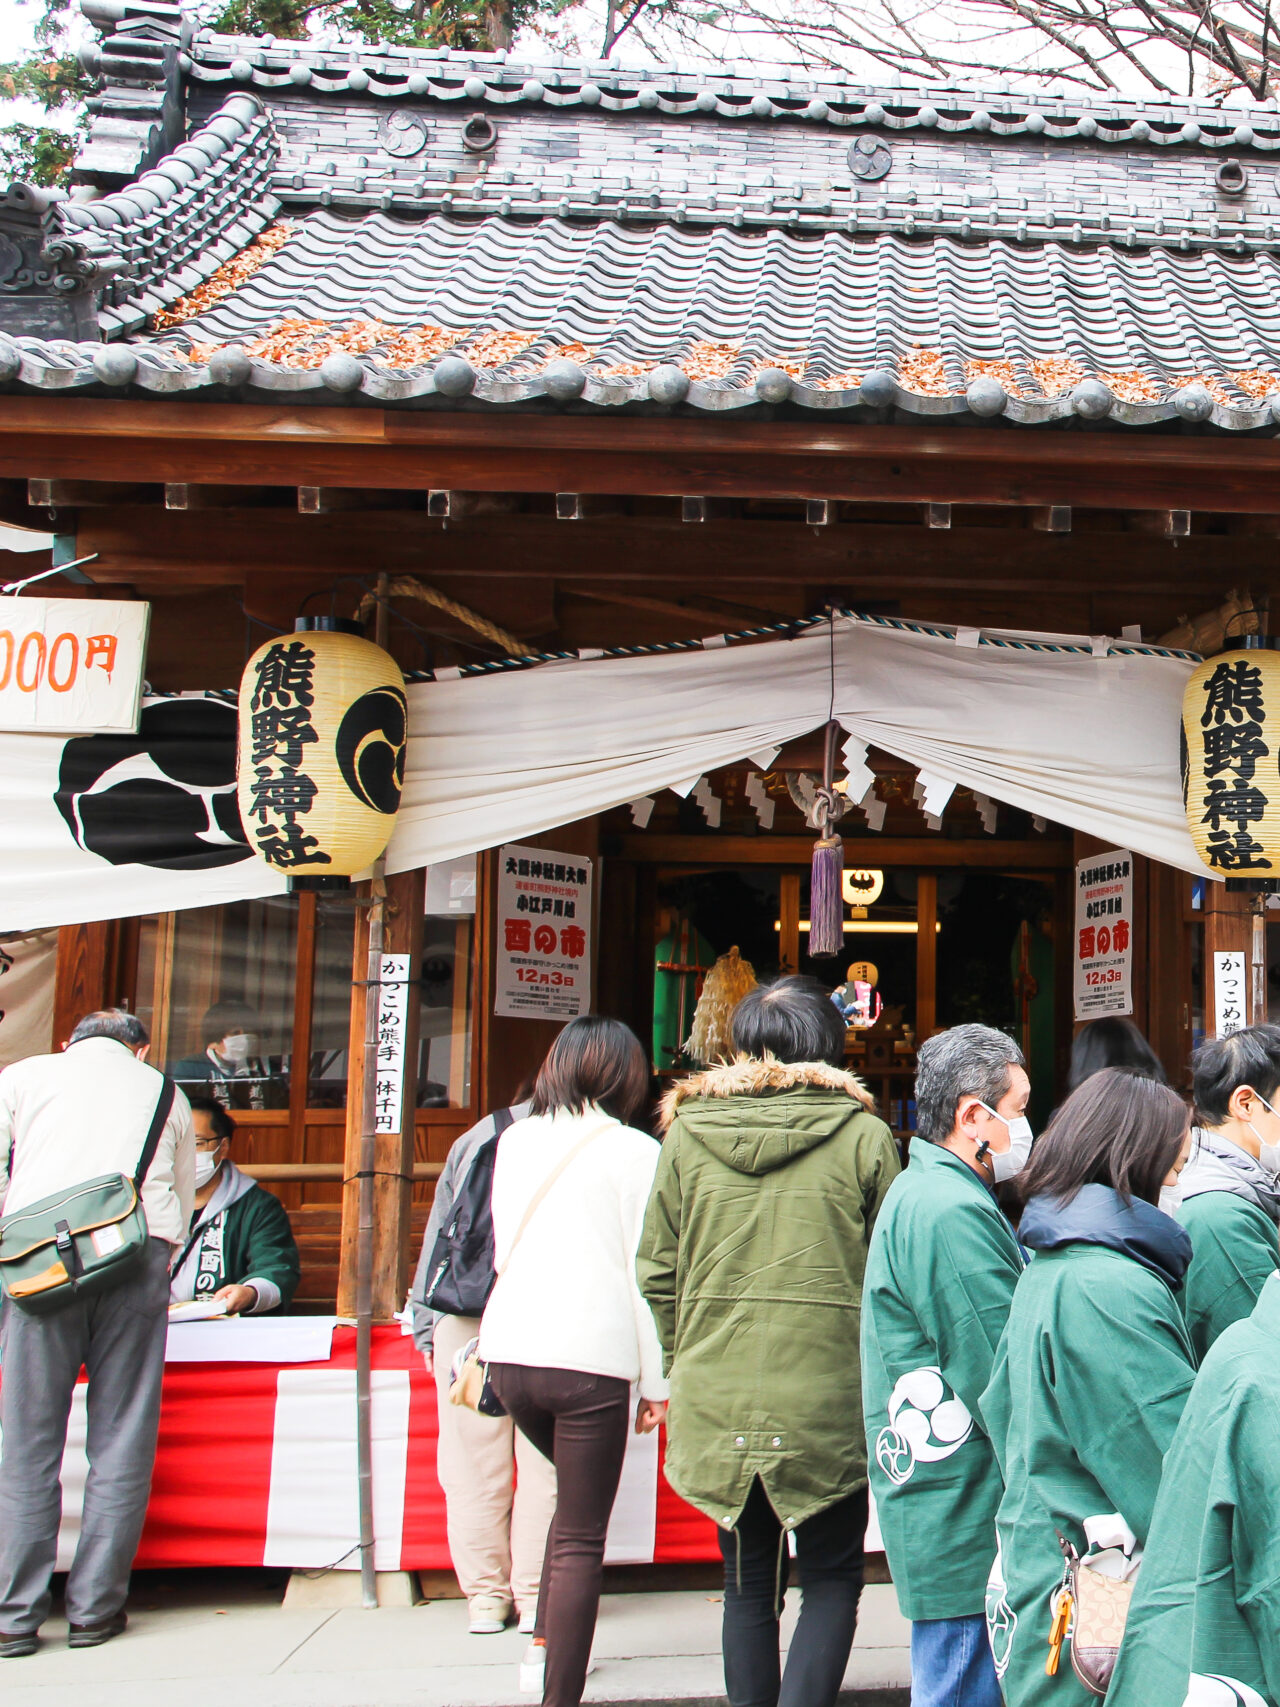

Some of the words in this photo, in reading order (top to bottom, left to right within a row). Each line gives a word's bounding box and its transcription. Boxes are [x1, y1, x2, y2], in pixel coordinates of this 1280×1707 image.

[248, 641, 332, 867] 熊野神社
[1200, 660, 1272, 871] 熊野神社
[504, 918, 586, 959] 酉の市
[1079, 919, 1130, 960] 酉の市
[515, 968, 574, 986] 12月3日
[1086, 969, 1122, 985] 12月3日
